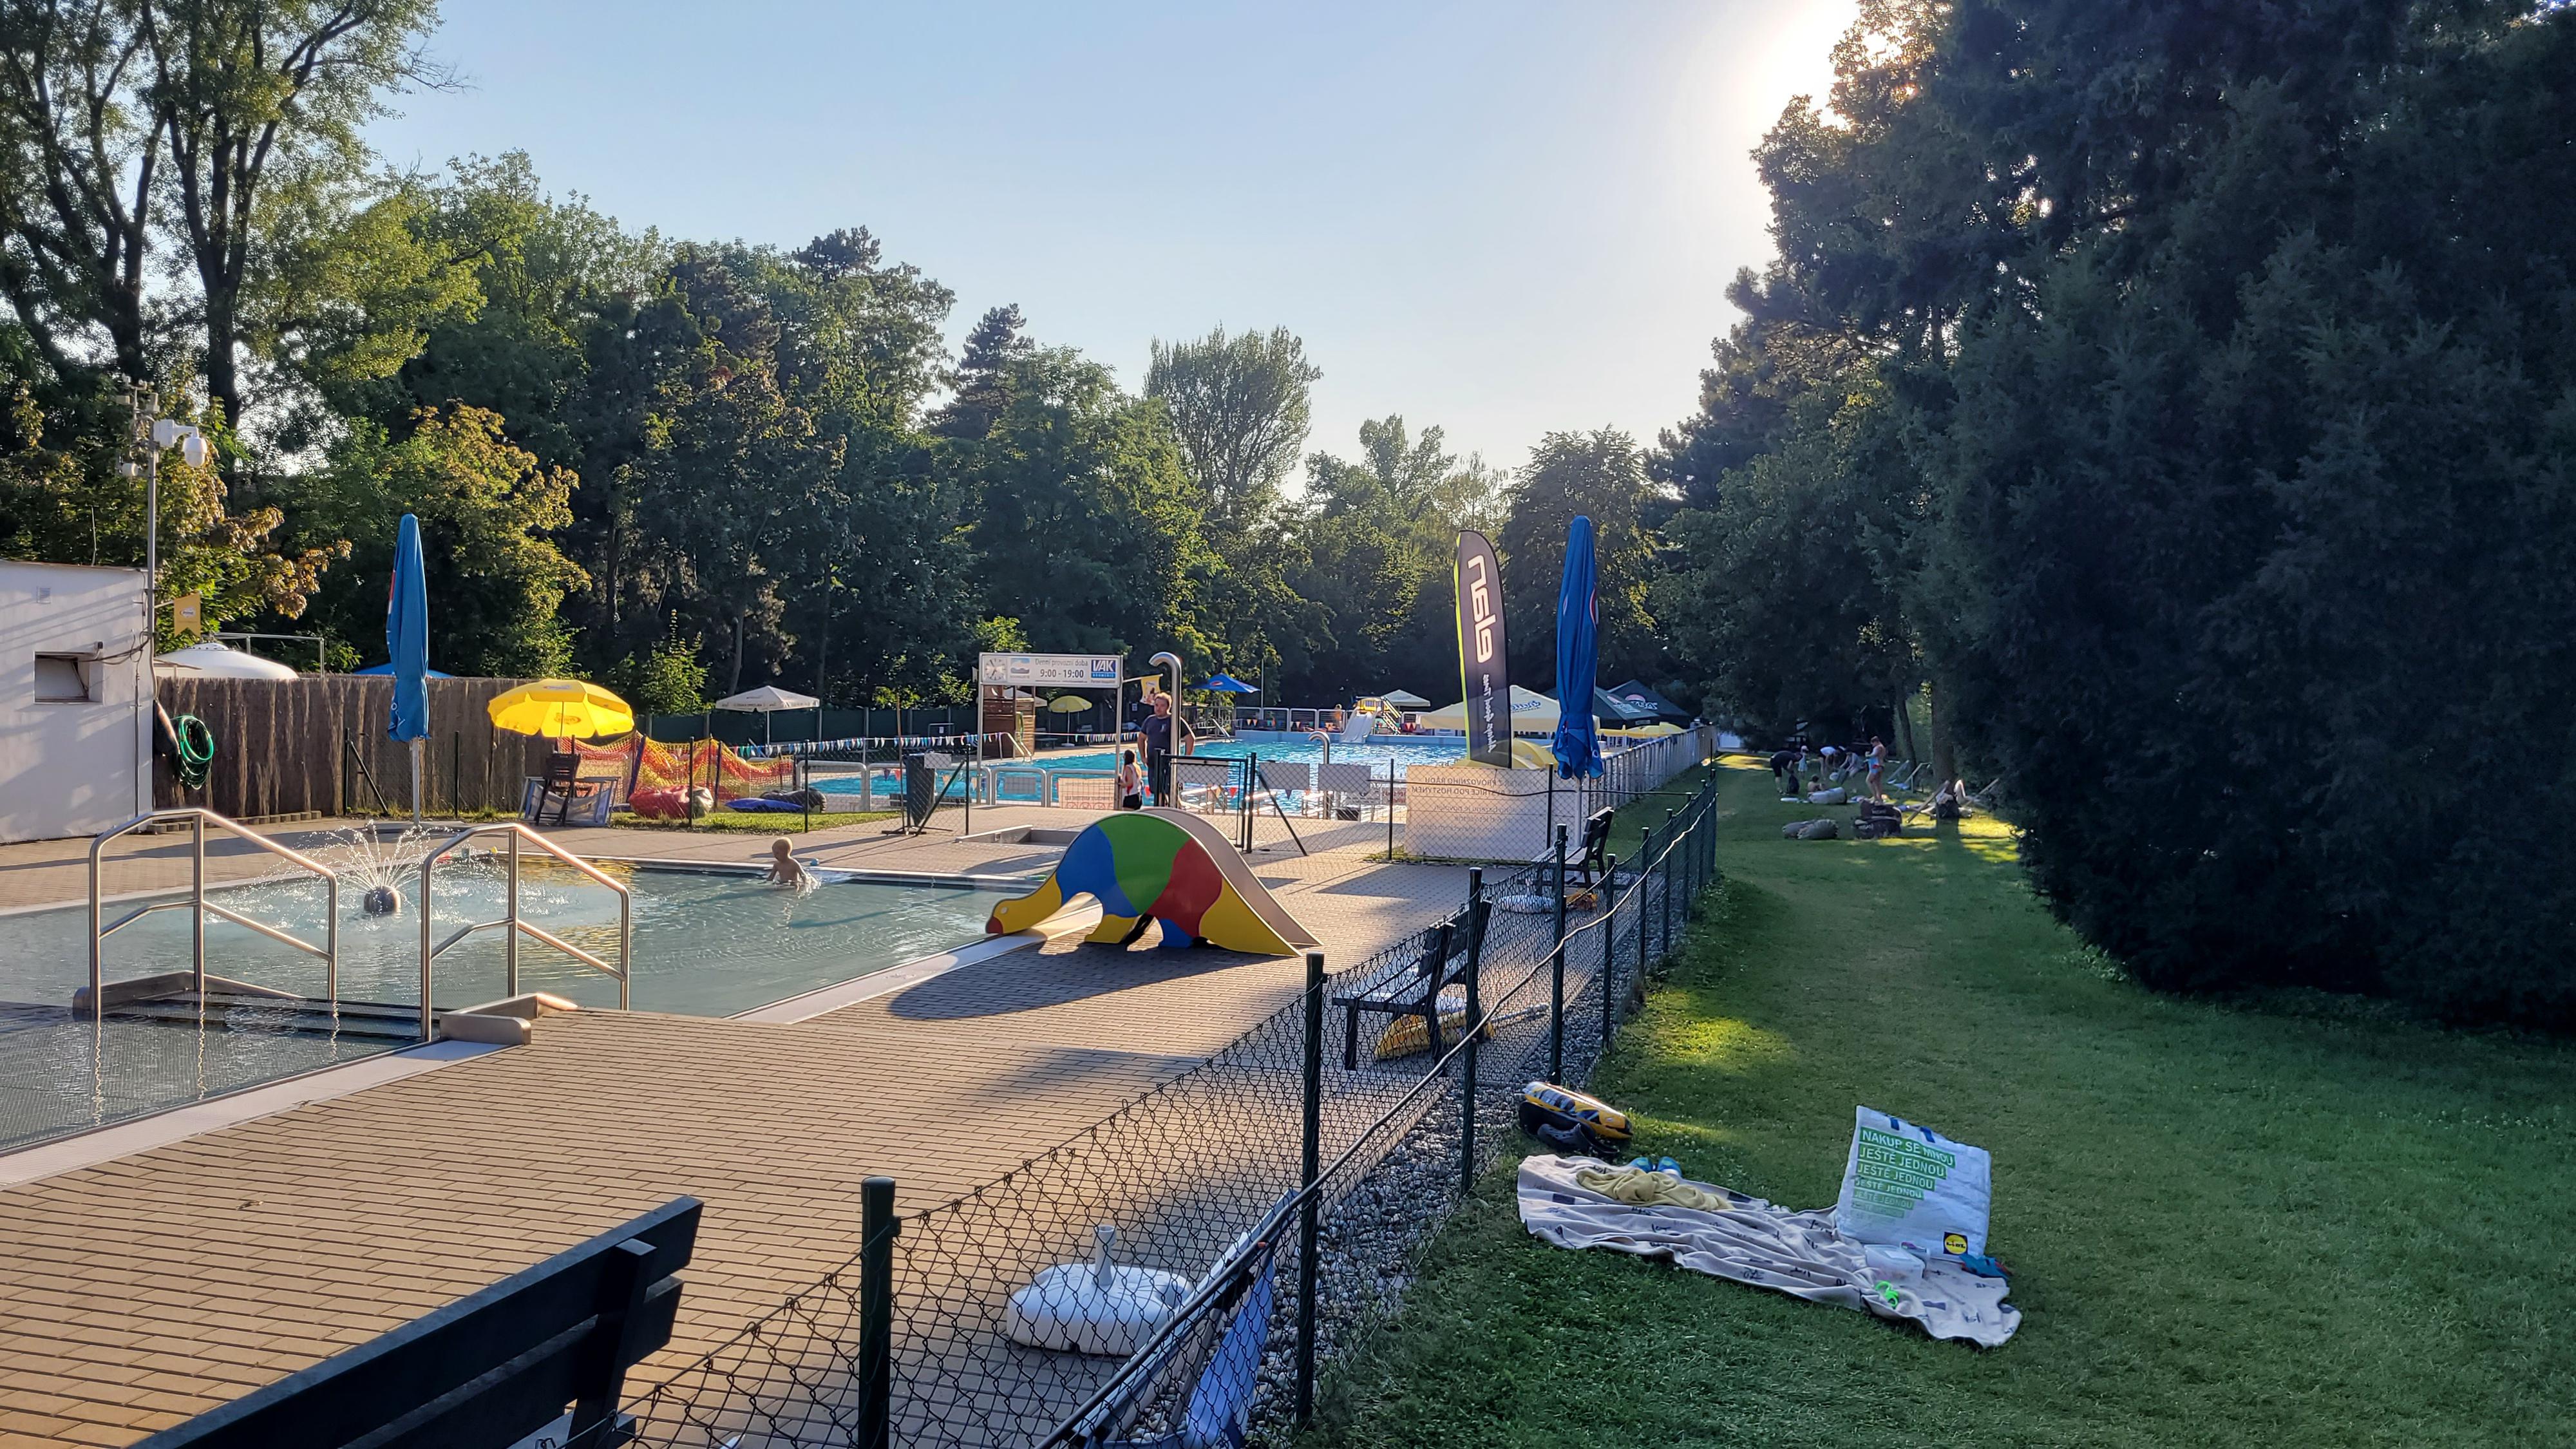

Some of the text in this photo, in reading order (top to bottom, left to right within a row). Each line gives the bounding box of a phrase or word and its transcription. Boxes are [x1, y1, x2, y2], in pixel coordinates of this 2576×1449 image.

[1093, 660, 1113, 672] VAK
[1040, 669, 1057, 677] 9:00
[1063, 670, 1084, 678] 19:00
[1862, 1130, 1953, 1166] NAKUP SE MNOU
[1899, 1156, 1944, 1177] JEDNOU
[1893, 1171, 1933, 1189] JEDNOU
[1887, 1185, 1922, 1198] JEDNOU
[1880, 1197, 1913, 1209] JEDNOU
